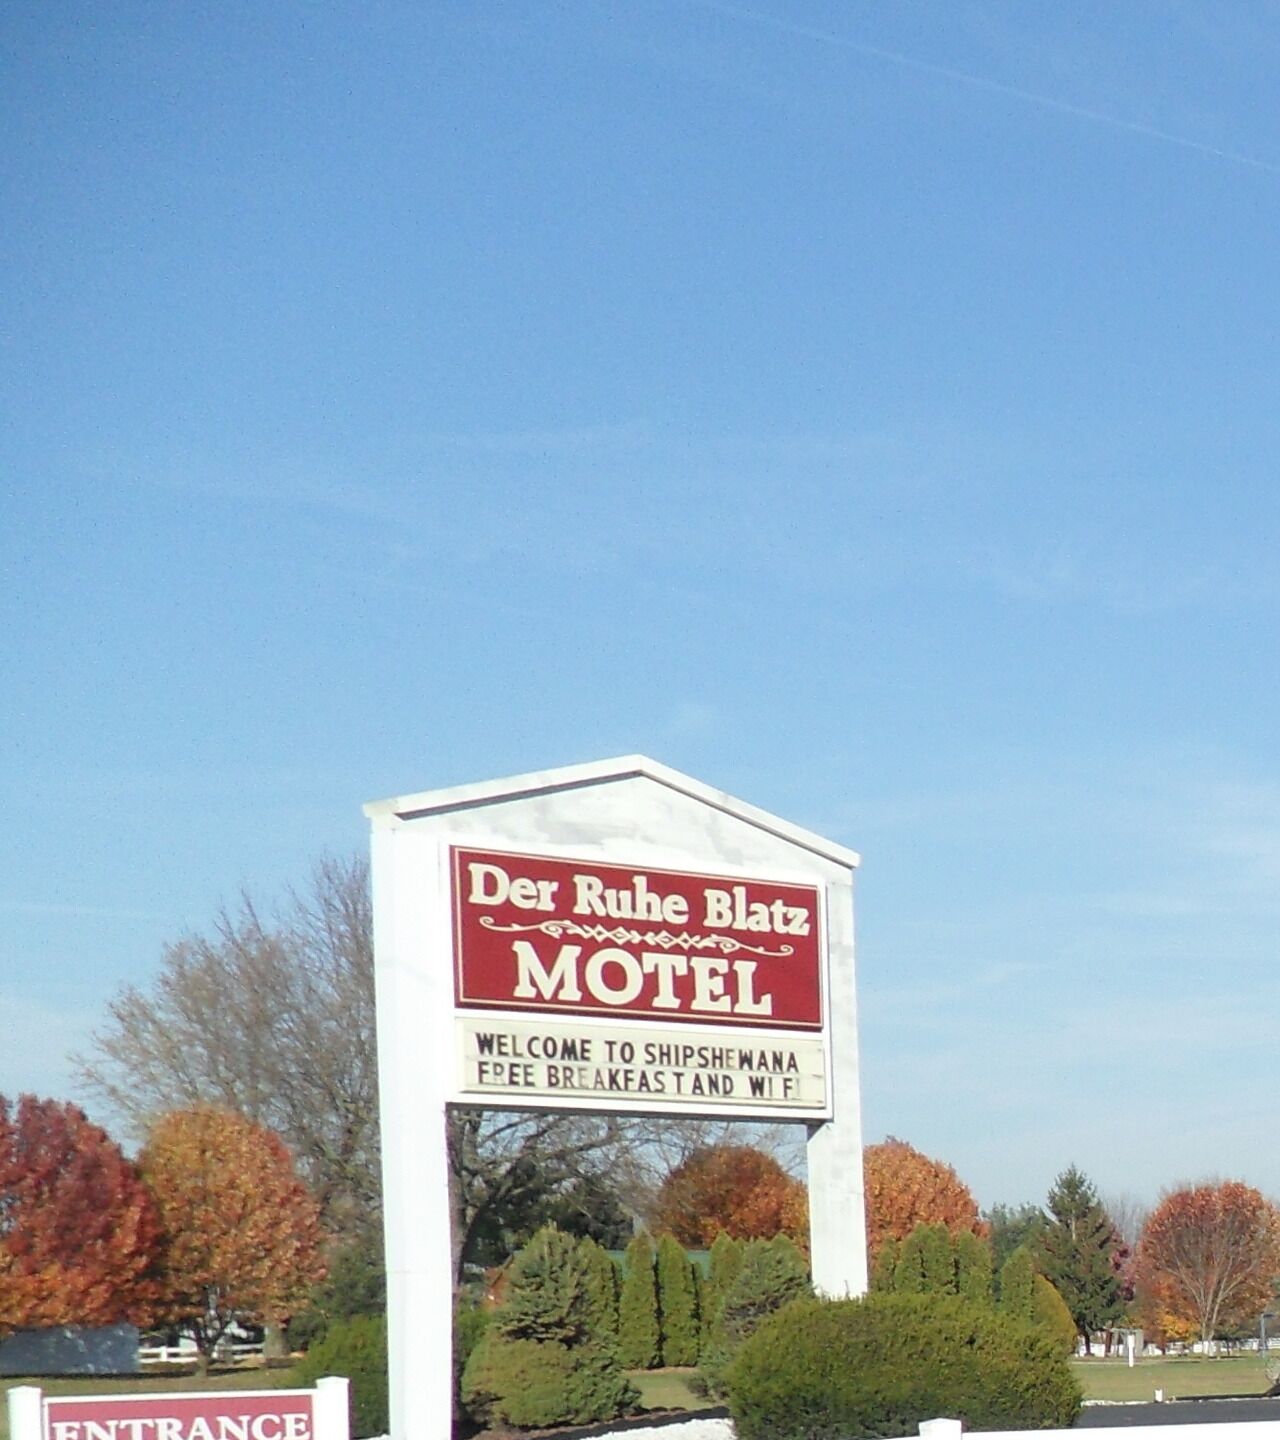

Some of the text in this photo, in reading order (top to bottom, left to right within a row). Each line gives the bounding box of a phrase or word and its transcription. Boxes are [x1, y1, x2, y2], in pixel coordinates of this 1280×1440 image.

[467, 862, 811, 936] Der Ruhe Blatz
[512, 940, 773, 1017] MOTEL
[475, 1032, 800, 1074] WELCOME TO SHIPSHEWANA
[478, 1061, 535, 1087] FREE
[547, 1065, 684, 1095] BREAKFAST
[691, 1073, 734, 1096] AND
